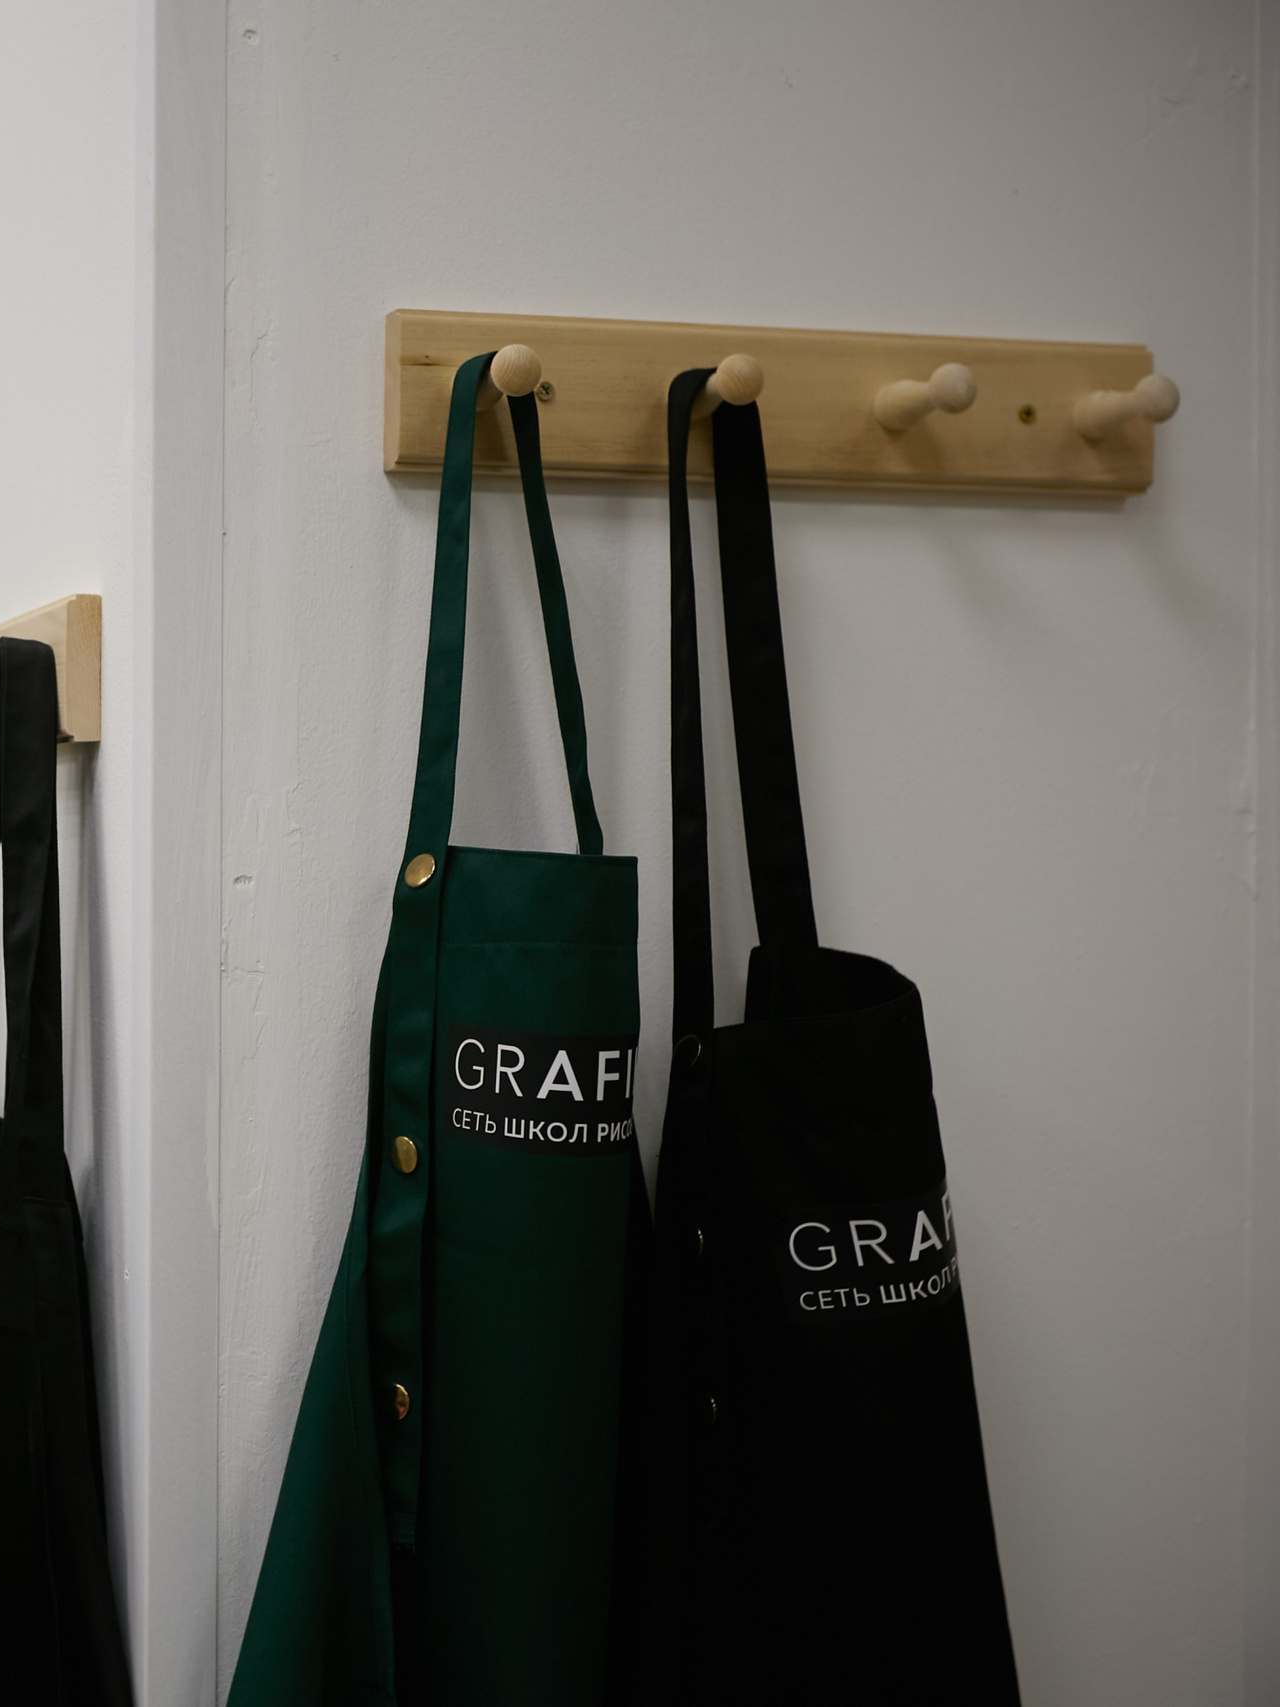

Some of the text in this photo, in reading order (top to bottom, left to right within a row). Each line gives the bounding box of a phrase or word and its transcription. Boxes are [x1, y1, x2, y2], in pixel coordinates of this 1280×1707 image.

[453, 1037, 635, 1102] GRAFI
[451, 1107, 497, 1135] СЕТЬ
[503, 1116, 588, 1144] ШКОЛ
[798, 1286, 871, 1312] СЕТЬ
[879, 1265, 952, 1305] ШКОЛ
